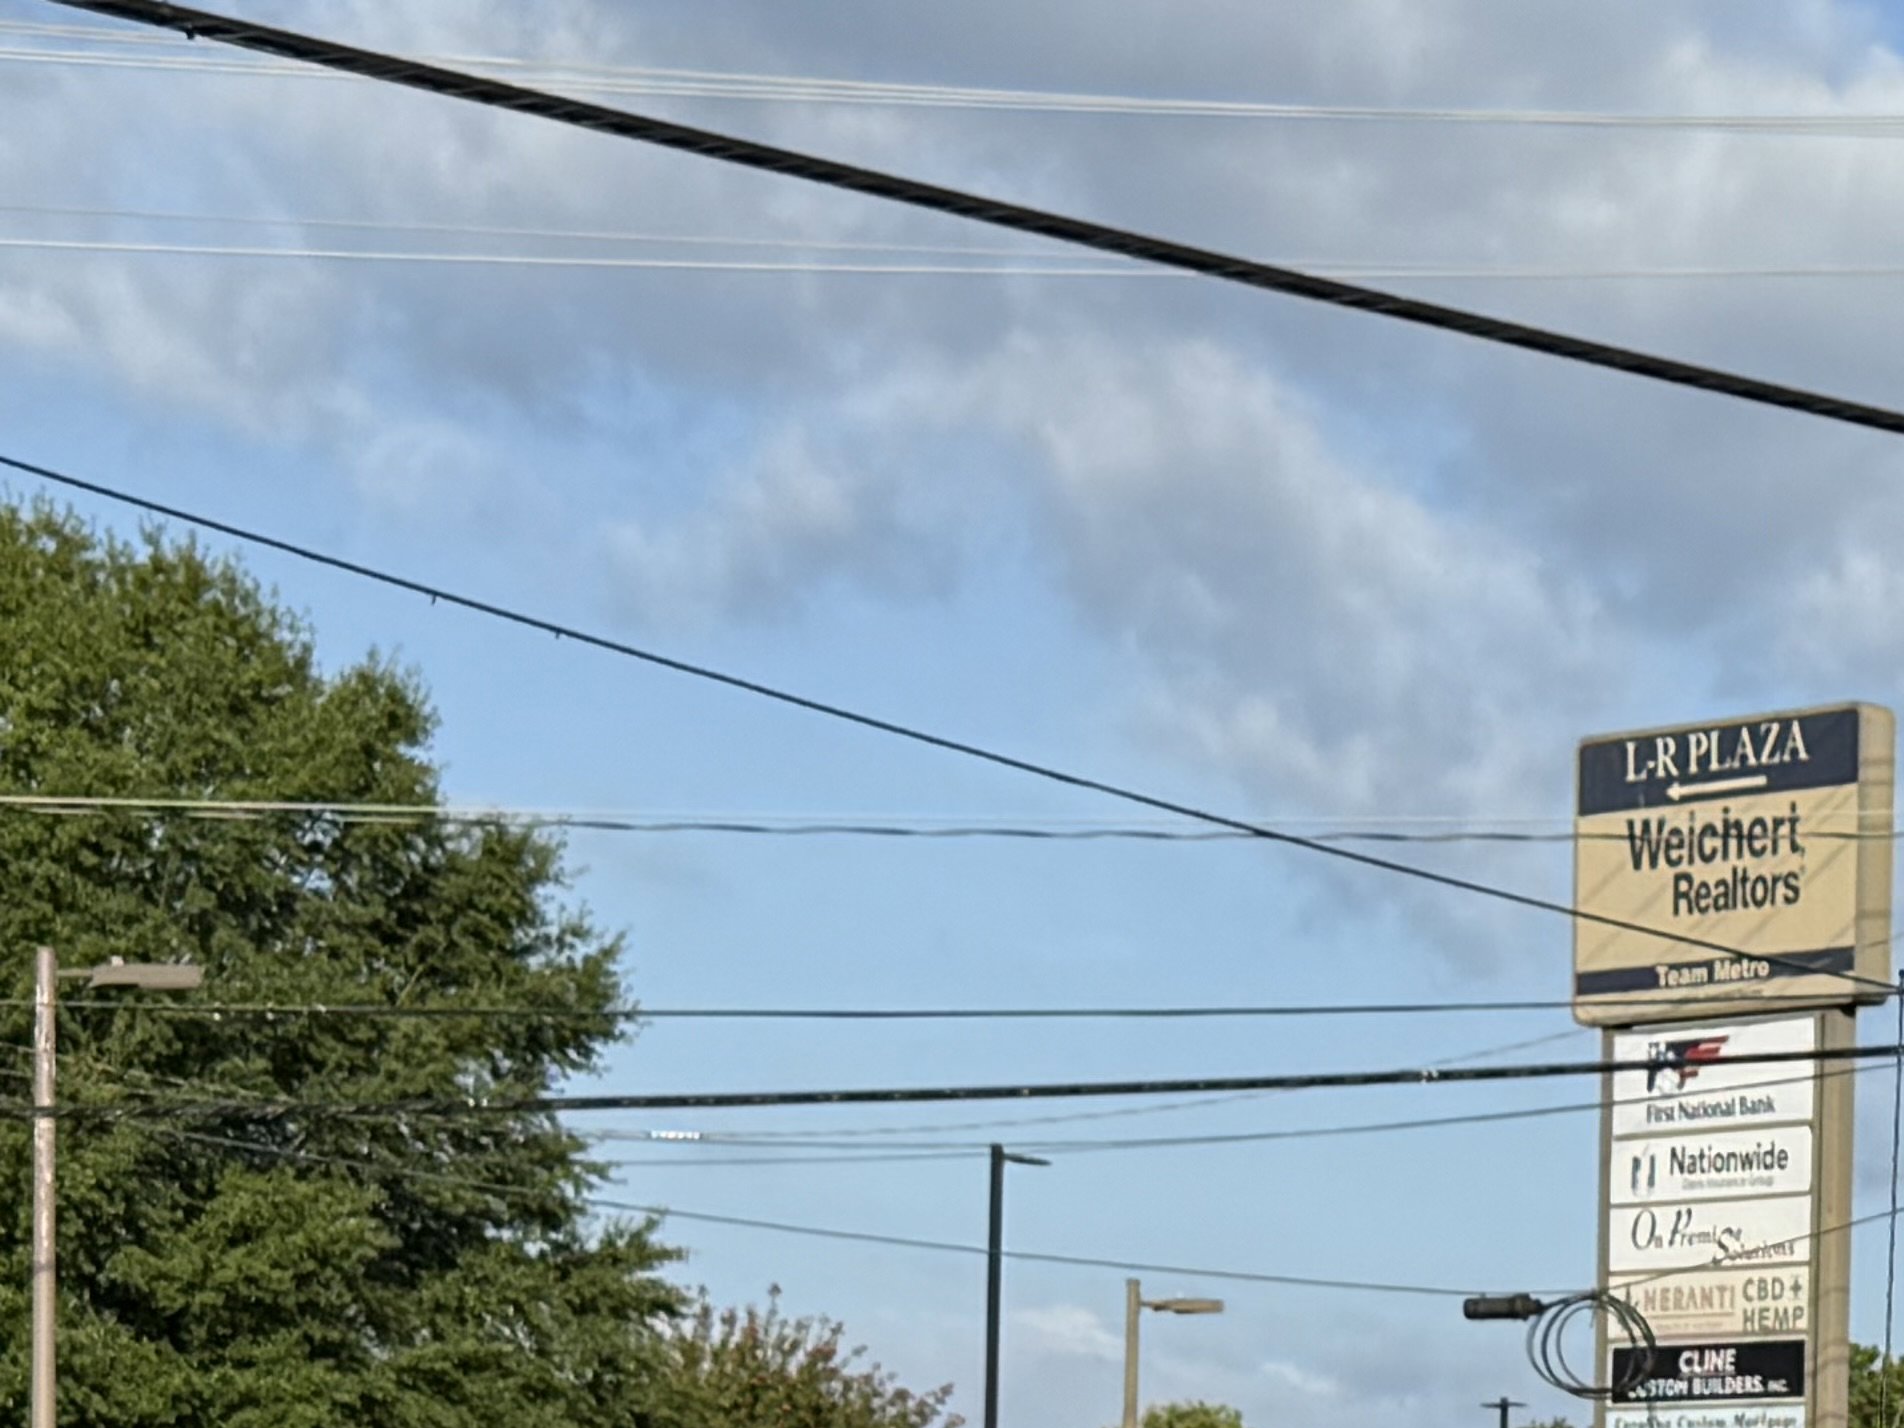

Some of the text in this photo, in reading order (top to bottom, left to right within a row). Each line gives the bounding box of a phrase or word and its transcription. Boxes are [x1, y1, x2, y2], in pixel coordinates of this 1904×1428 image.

[1625, 720, 1810, 783] L-R PLAZA
[1656, 956, 1770, 987] Team Metro
[1646, 1094, 1776, 1123] First National Bank
[1669, 1140, 1789, 1176] Nationwide
[1742, 1276, 1785, 1302] CBD
[1741, 1306, 1805, 1332] HEMP
[1678, 1347, 1737, 1375] CLINE
[1628, 1378, 1689, 1399] STOM
